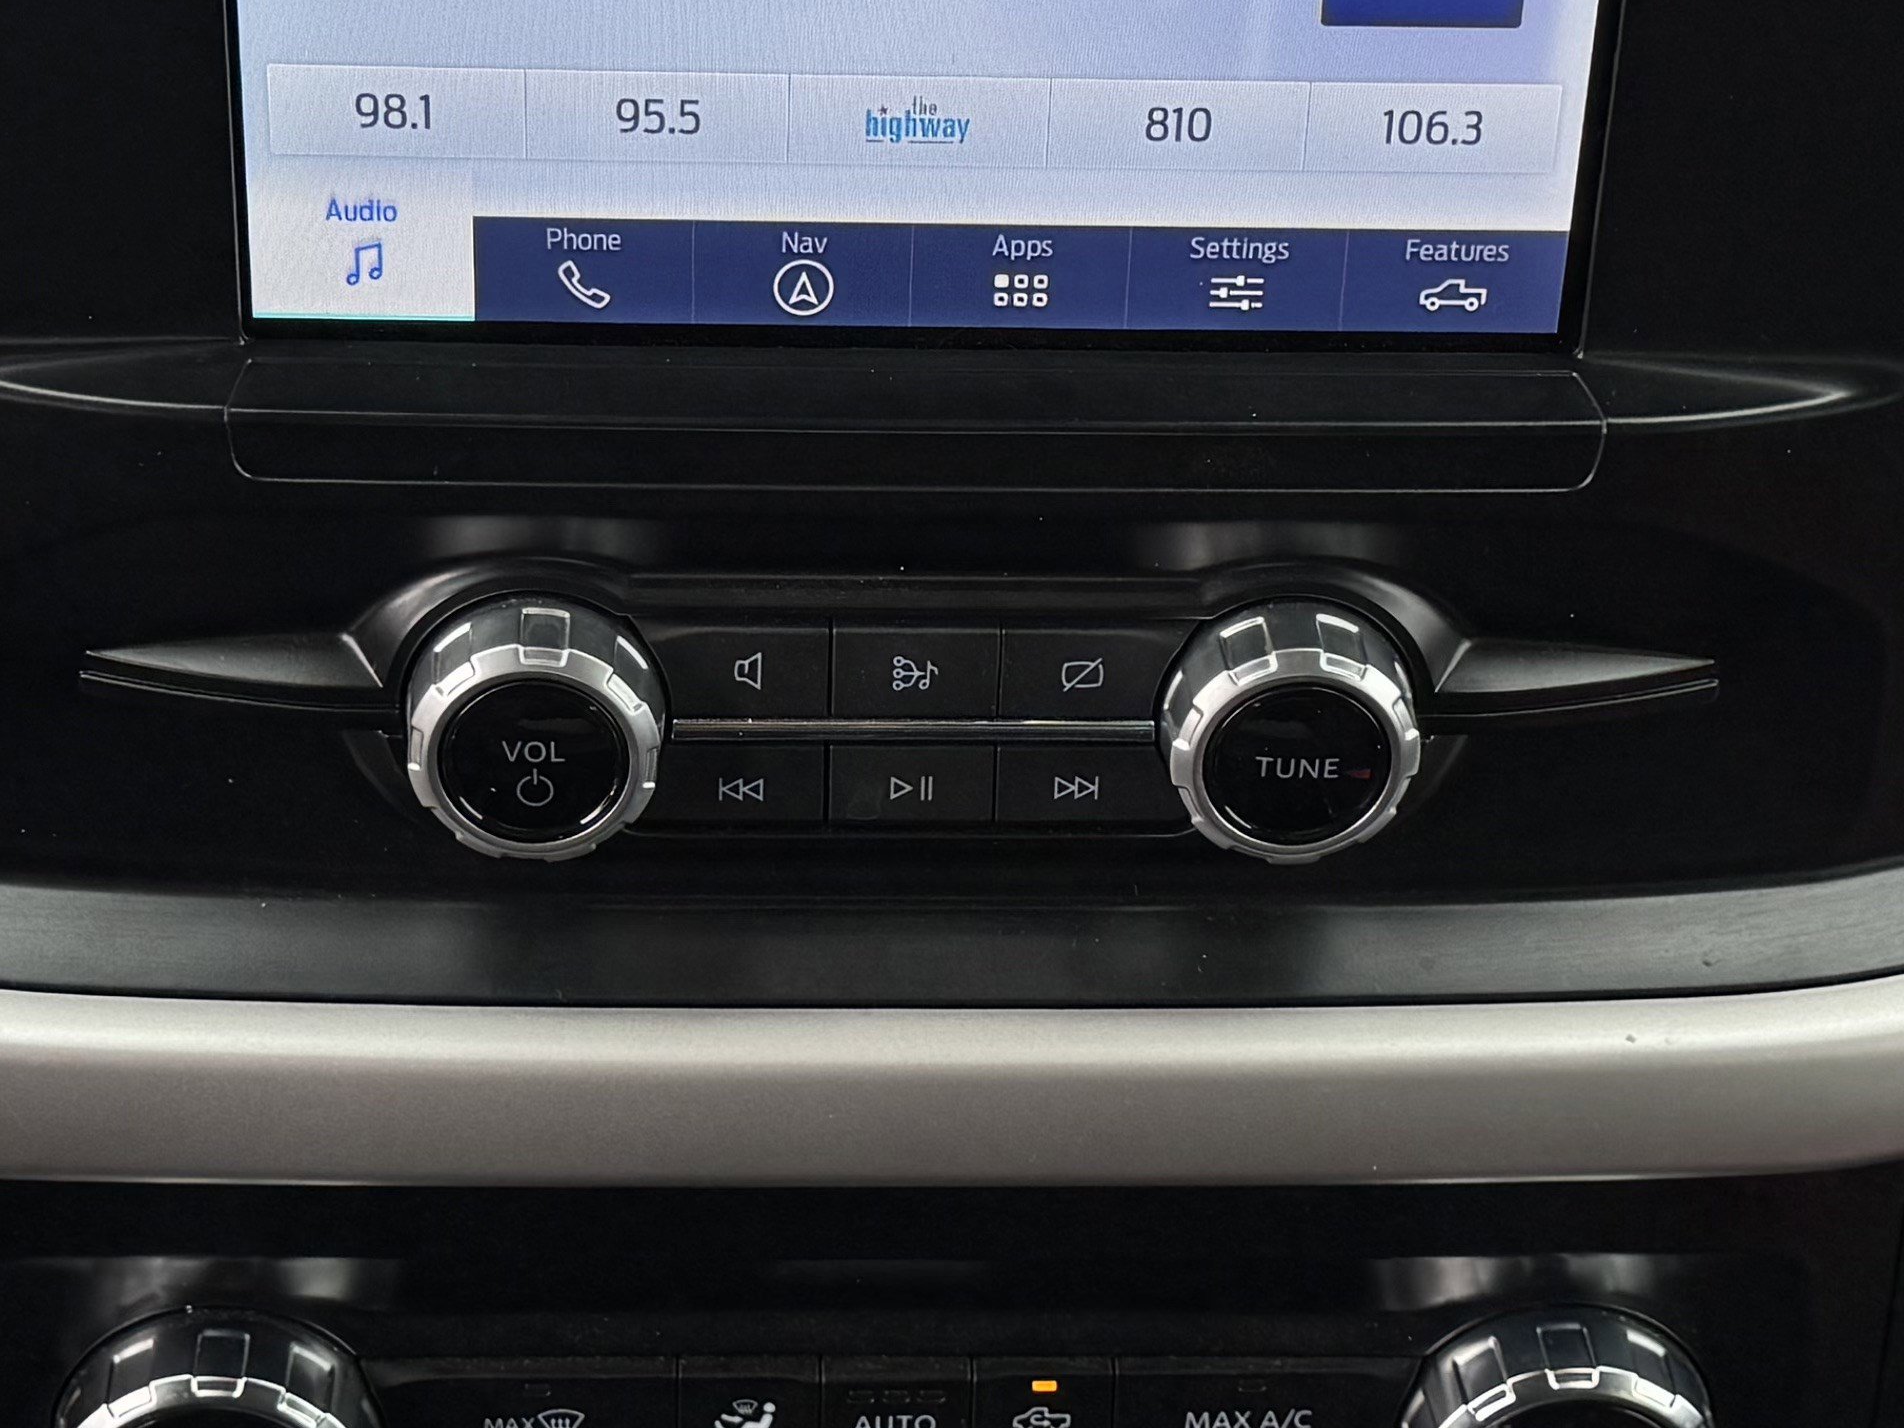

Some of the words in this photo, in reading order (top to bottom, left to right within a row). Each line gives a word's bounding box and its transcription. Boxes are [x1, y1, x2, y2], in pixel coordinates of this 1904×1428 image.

[353, 91, 433, 132] 98.1
[615, 97, 702, 137] 95.5
[912, 95, 938, 116] the
[865, 108, 971, 145] highway
[1144, 106, 1213, 144] 810
[1381, 108, 1484, 147] 106.3
[324, 197, 398, 224] Audio
[545, 227, 622, 253] Phone
[781, 230, 828, 254] Nav
[991, 234, 1054, 263] Apps
[1189, 235, 1291, 265] Settings
[1405, 239, 1510, 263] Features
[501, 739, 566, 763] VOL
[1255, 757, 1340, 780] TUNE
